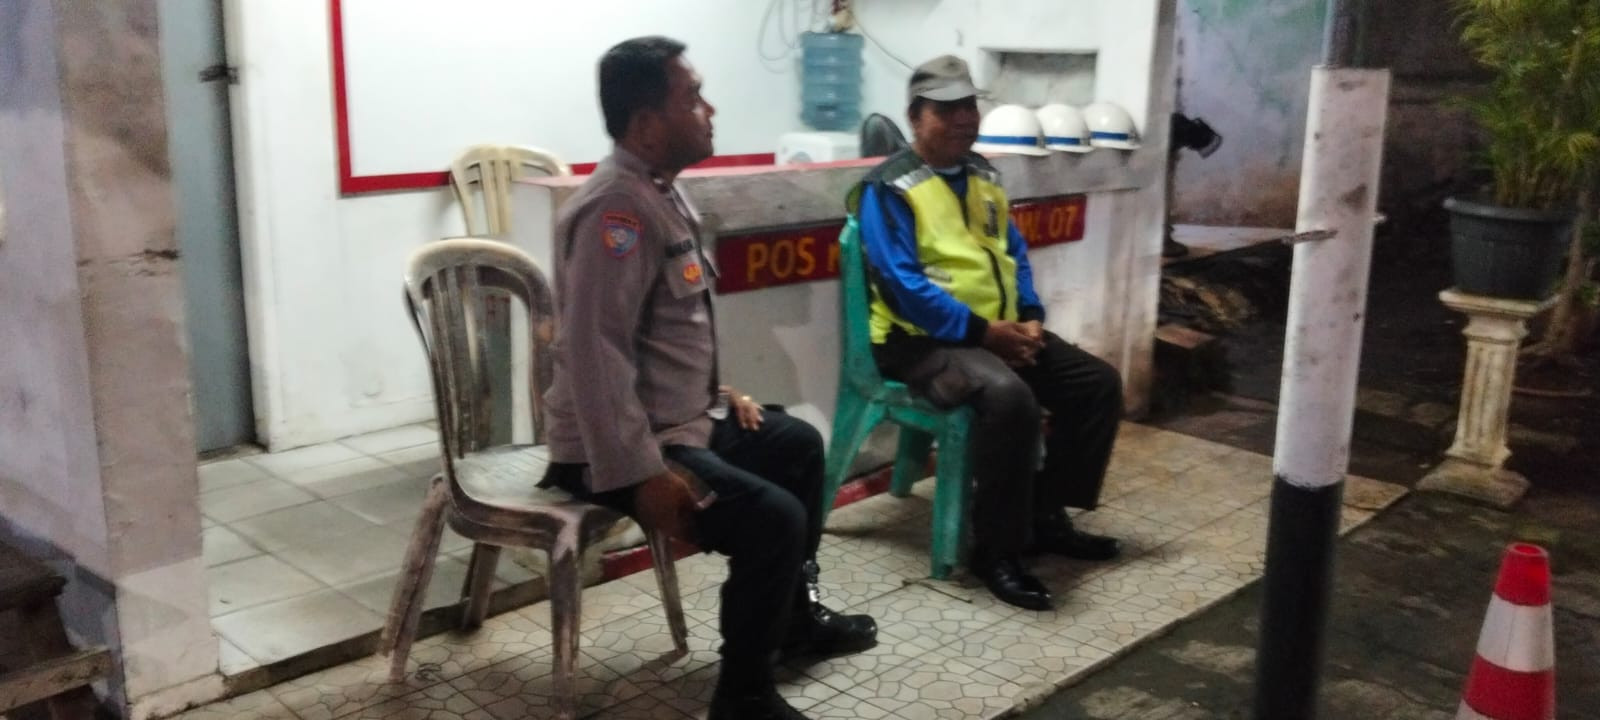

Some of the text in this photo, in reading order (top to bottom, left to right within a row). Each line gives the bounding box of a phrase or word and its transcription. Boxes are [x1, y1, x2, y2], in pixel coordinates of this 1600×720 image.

[747, 237, 816, 281] POS
[1013, 209, 1042, 241] W.
[1048, 206, 1078, 238] 07
